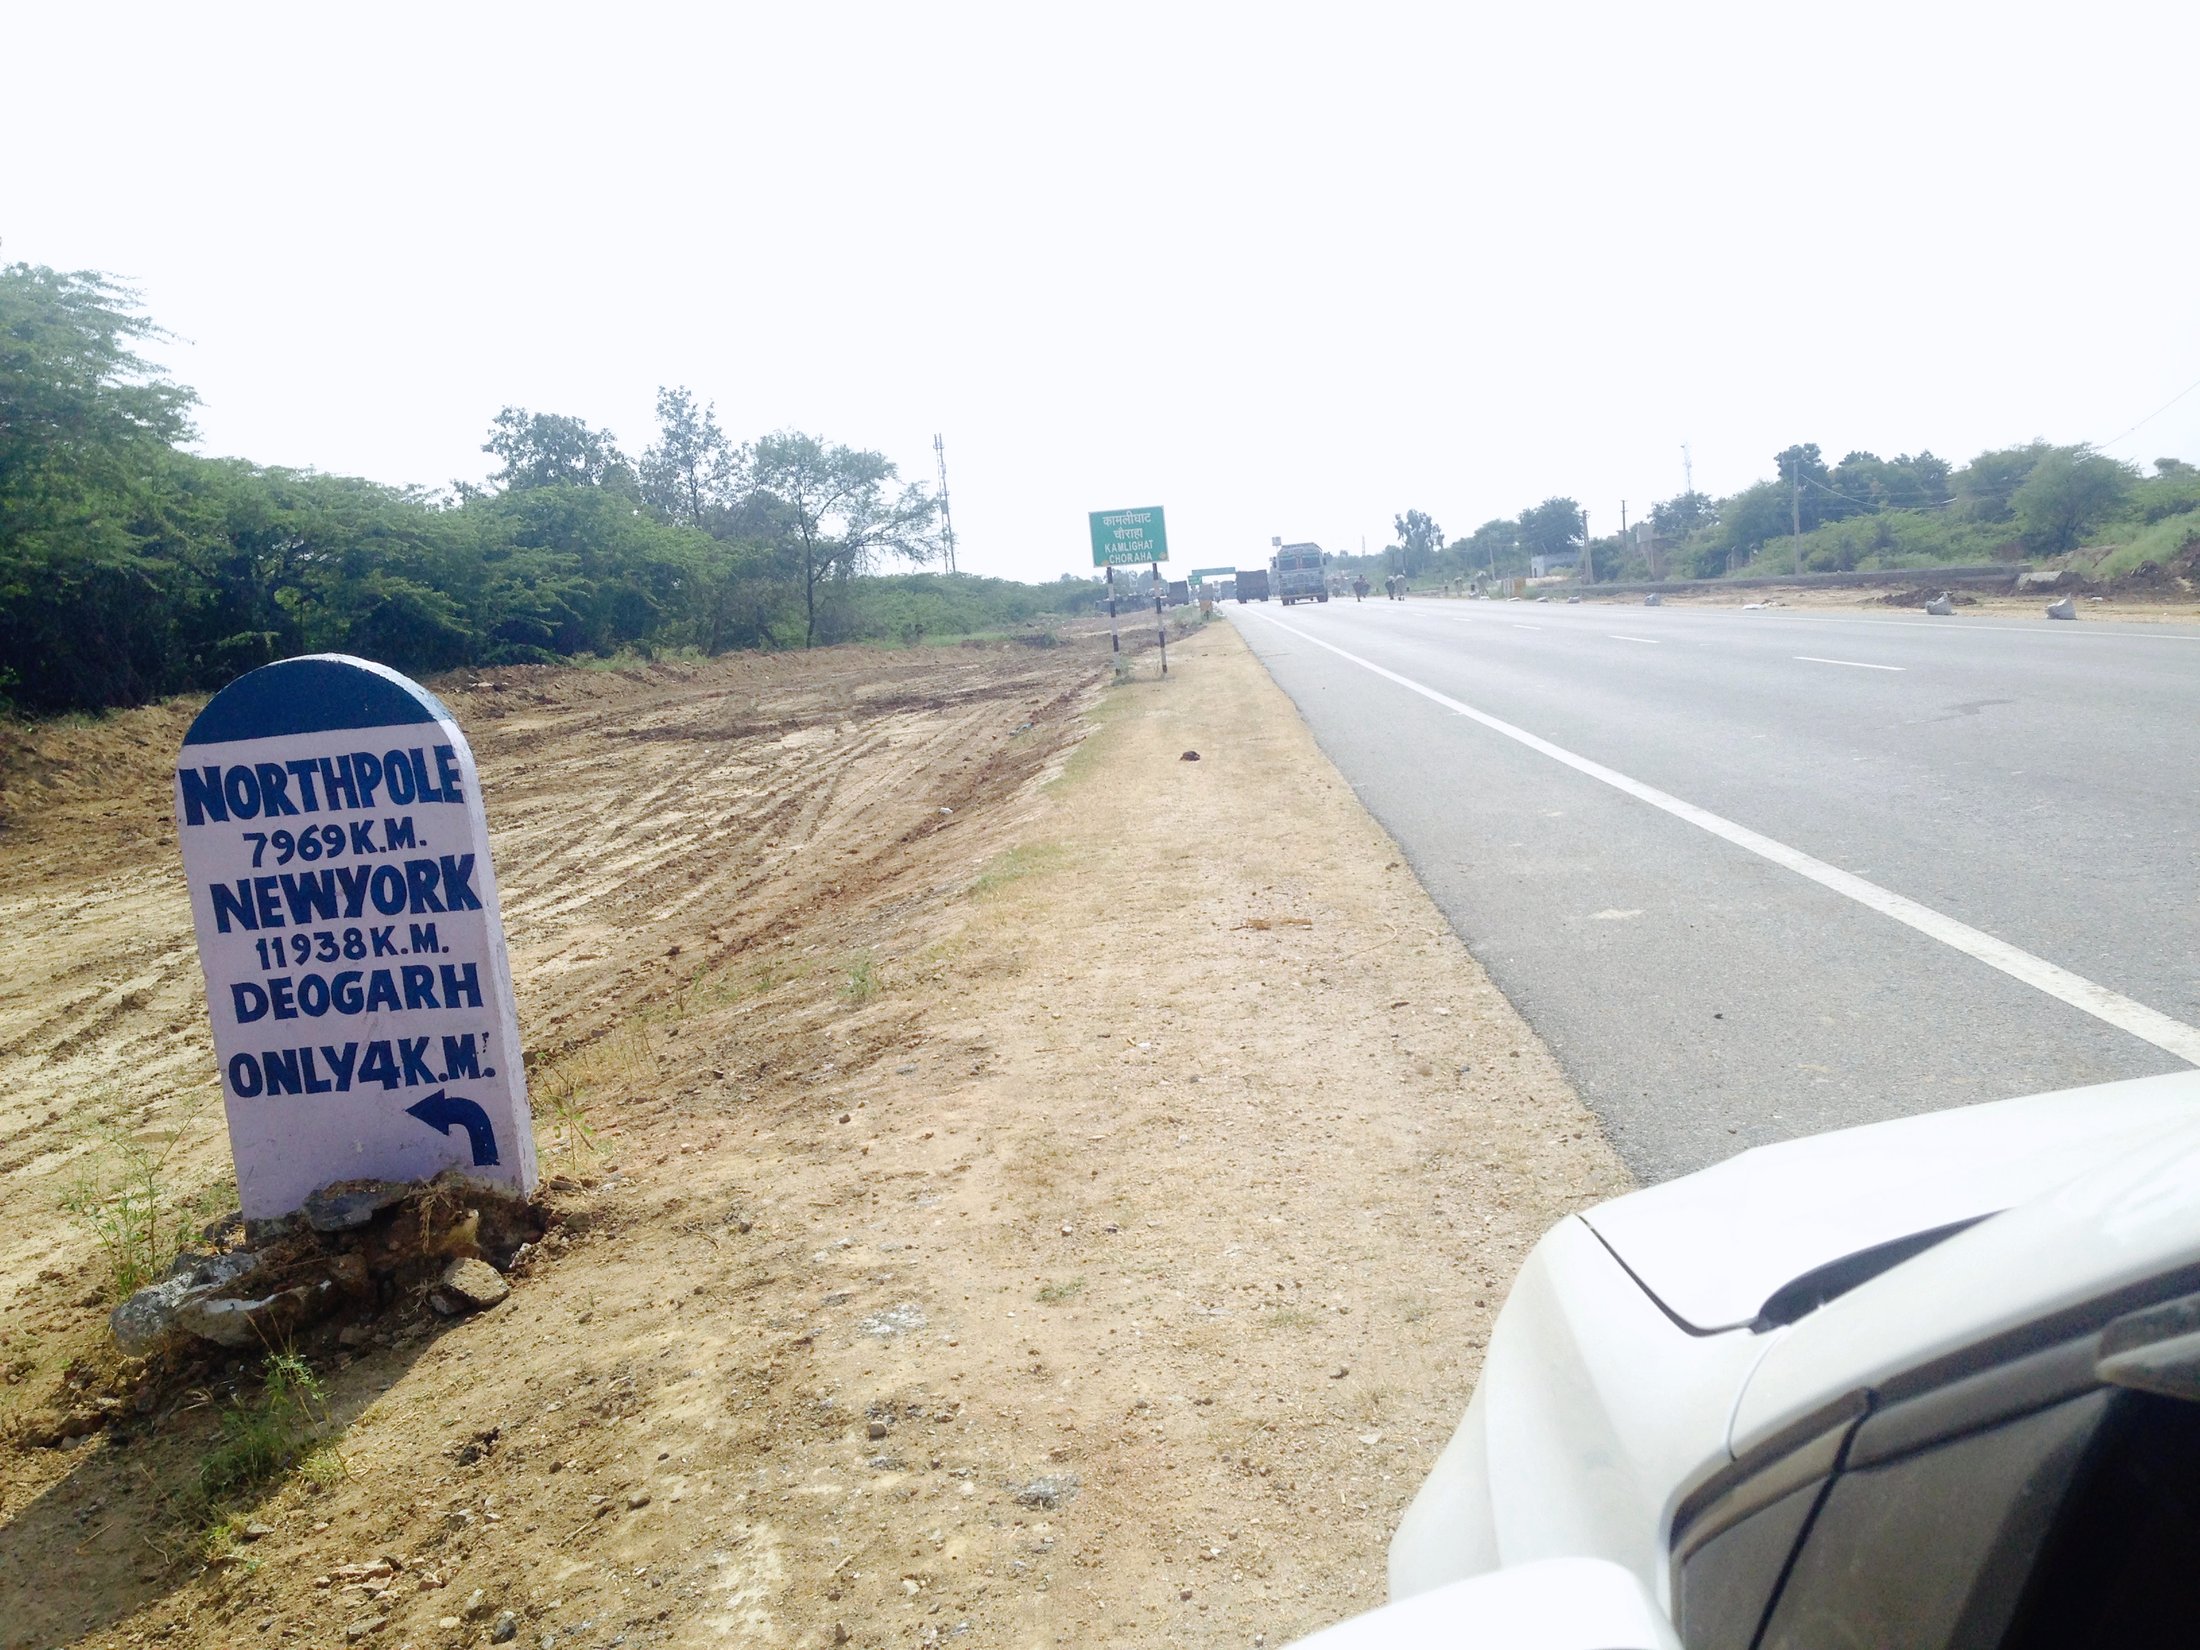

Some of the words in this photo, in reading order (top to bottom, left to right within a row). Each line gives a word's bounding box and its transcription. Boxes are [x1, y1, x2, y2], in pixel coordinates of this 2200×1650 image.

[1104, 540, 1153, 553] KAMLIGHAT
[1109, 551, 1153, 564] CHORAHA
[179, 745, 464, 826] NORTHPOLE
[231, 963, 484, 1024] DEOGARH
